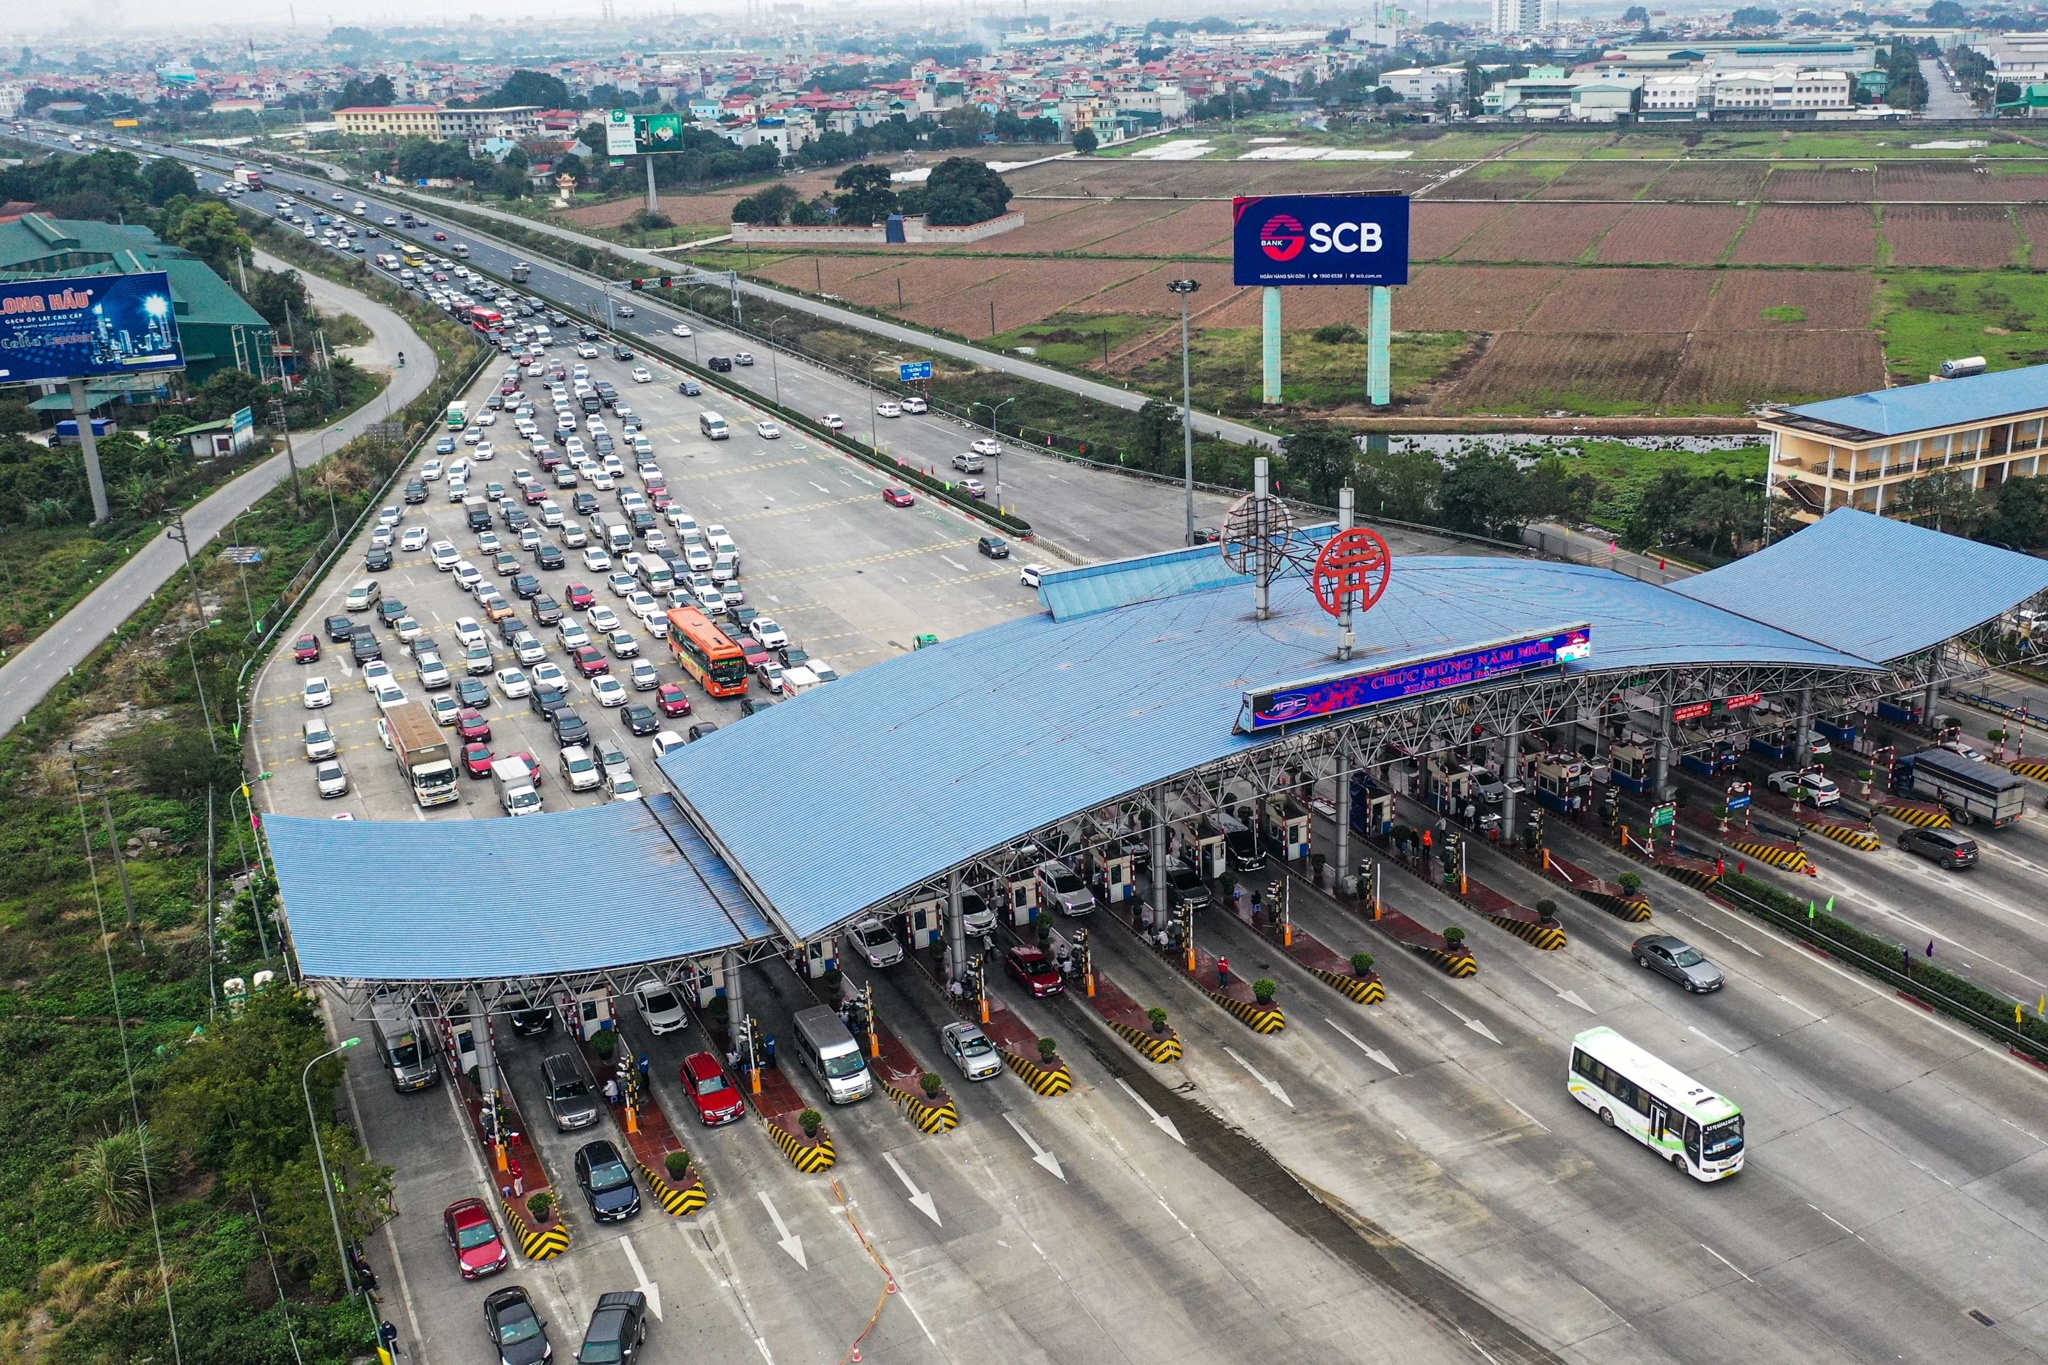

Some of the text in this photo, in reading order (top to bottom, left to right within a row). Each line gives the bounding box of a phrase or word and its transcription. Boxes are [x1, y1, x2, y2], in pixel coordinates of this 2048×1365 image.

[1309, 222, 1383, 254] SCB
[0, 287, 89, 315] ONG HẦU
[1371, 669, 1419, 690] CHÚC
[1423, 658, 1473, 679] MỪNG
[1477, 649, 1514, 667] NĂM
[1403, 680, 1435, 694] XUÂN
[1438, 672, 1472, 687] NHÂM
